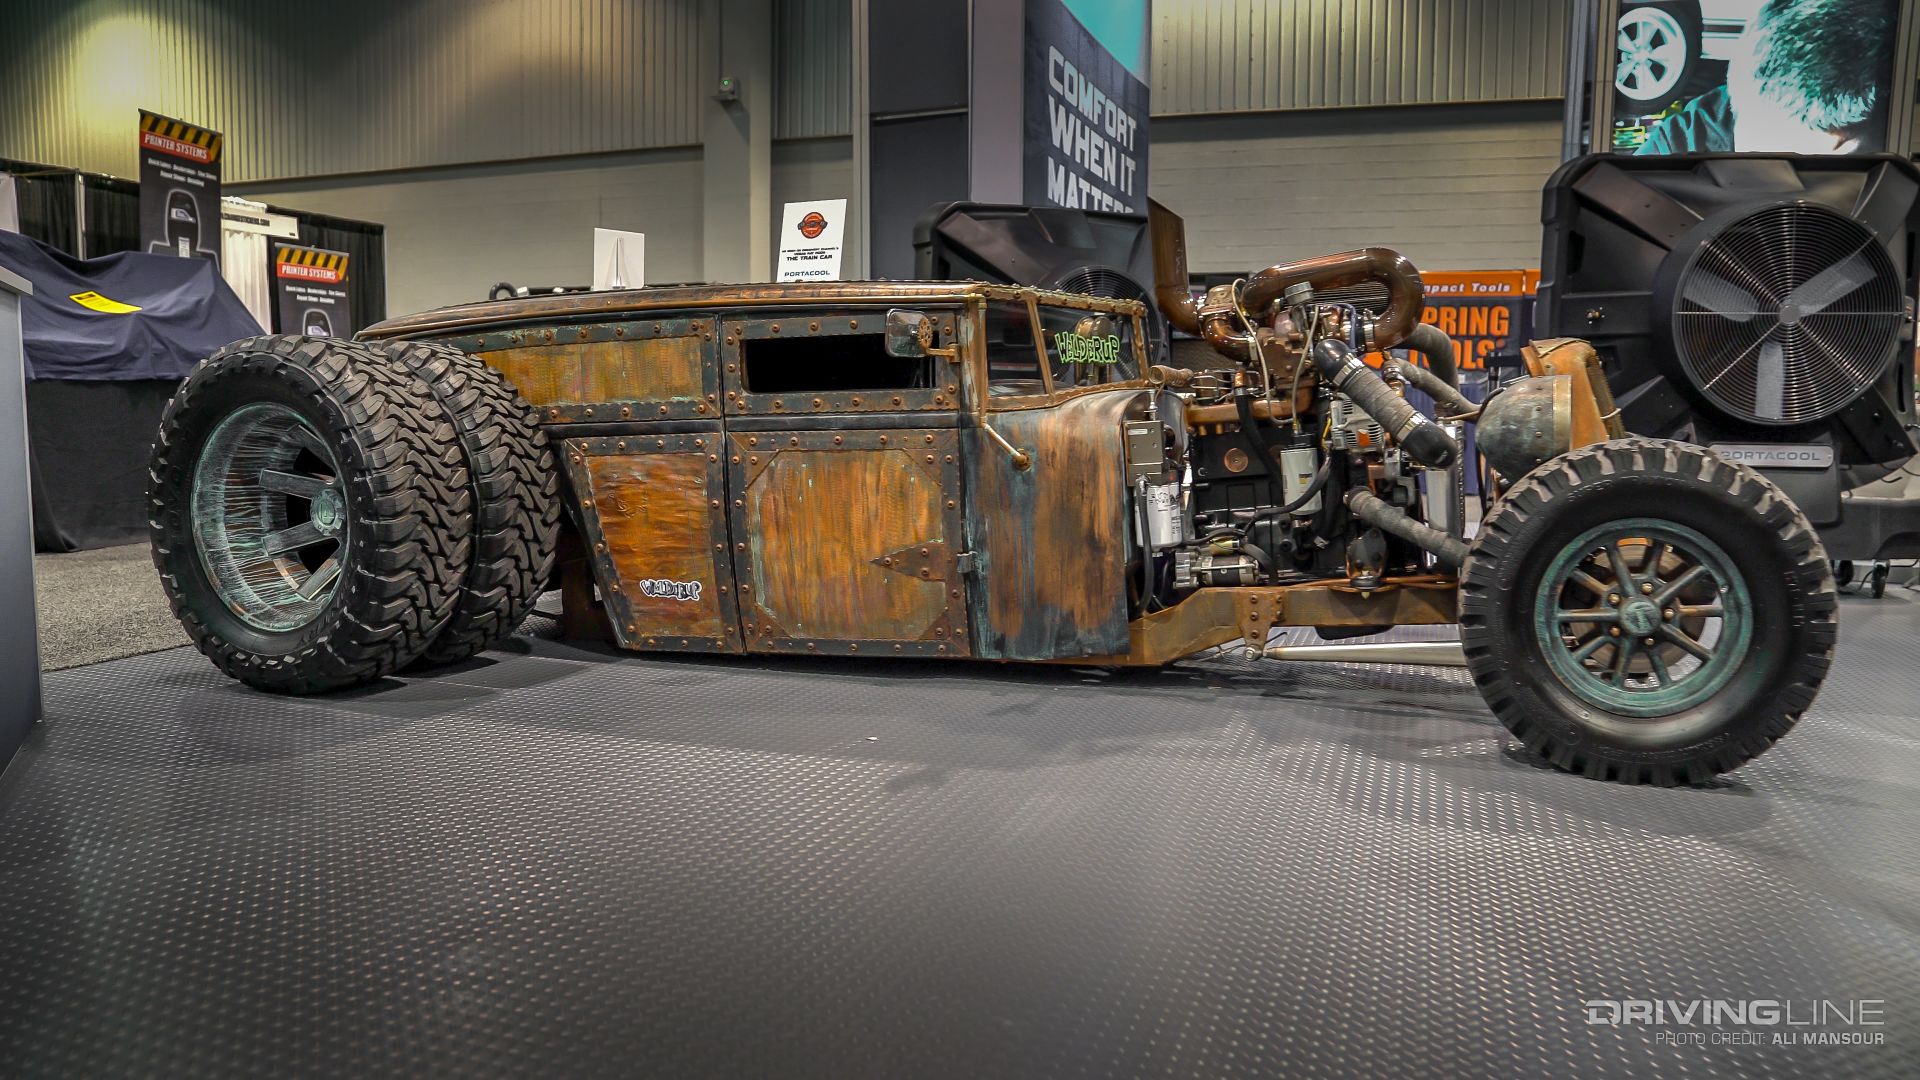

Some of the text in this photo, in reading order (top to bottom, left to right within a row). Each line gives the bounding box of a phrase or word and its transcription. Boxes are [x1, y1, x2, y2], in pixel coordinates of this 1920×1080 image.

[1049, 46, 1136, 151] COMFORT
[144, 133, 208, 160] PRINTER SYSTEMS
[1049, 95, 1136, 196] WHEN IT
[1048, 157, 1134, 213] MATTE
[281, 265, 336, 280] PRINTER SYSTEMS
[1424, 283, 1511, 293] mpact Tools
[1421, 306, 1509, 337] PRING
[1055, 332, 1120, 363] WELDERUP
